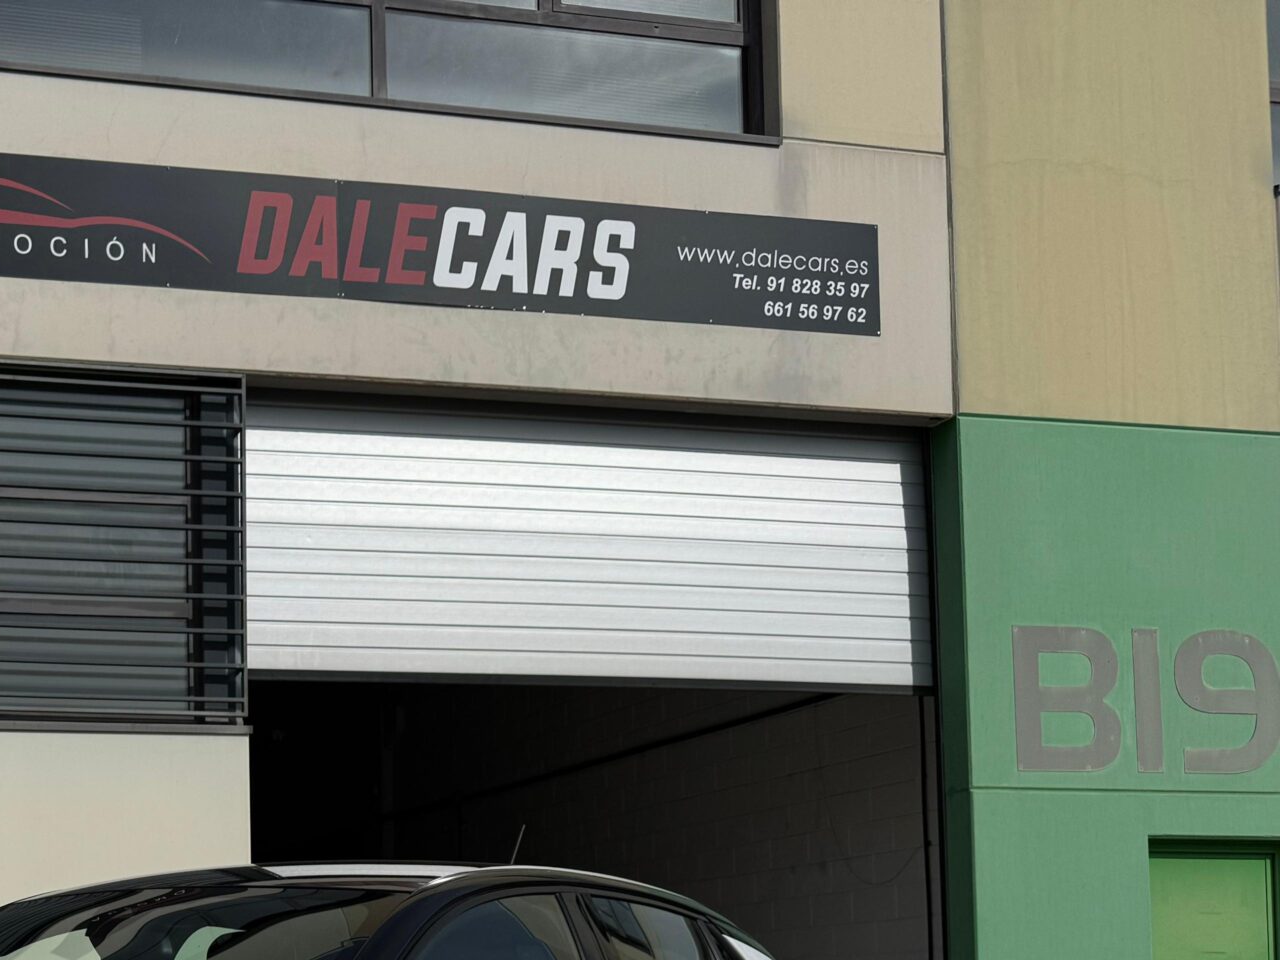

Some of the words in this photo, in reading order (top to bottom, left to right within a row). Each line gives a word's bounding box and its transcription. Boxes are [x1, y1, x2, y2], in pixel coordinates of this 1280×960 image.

[235, 189, 636, 301] DALECARS
[676, 245, 869, 275] www.dalecars.es
[732, 273, 761, 291] Tel.
[767, 275, 786, 292] 91
[791, 278, 821, 295] 828
[825, 280, 846, 297] 35
[850, 282, 870, 298] 97
[764, 301, 793, 318] 661
[798, 303, 819, 319] 56
[822, 305, 843, 321] 97
[847, 307, 867, 323] 62
[1011, 624, 1280, 775] B19
